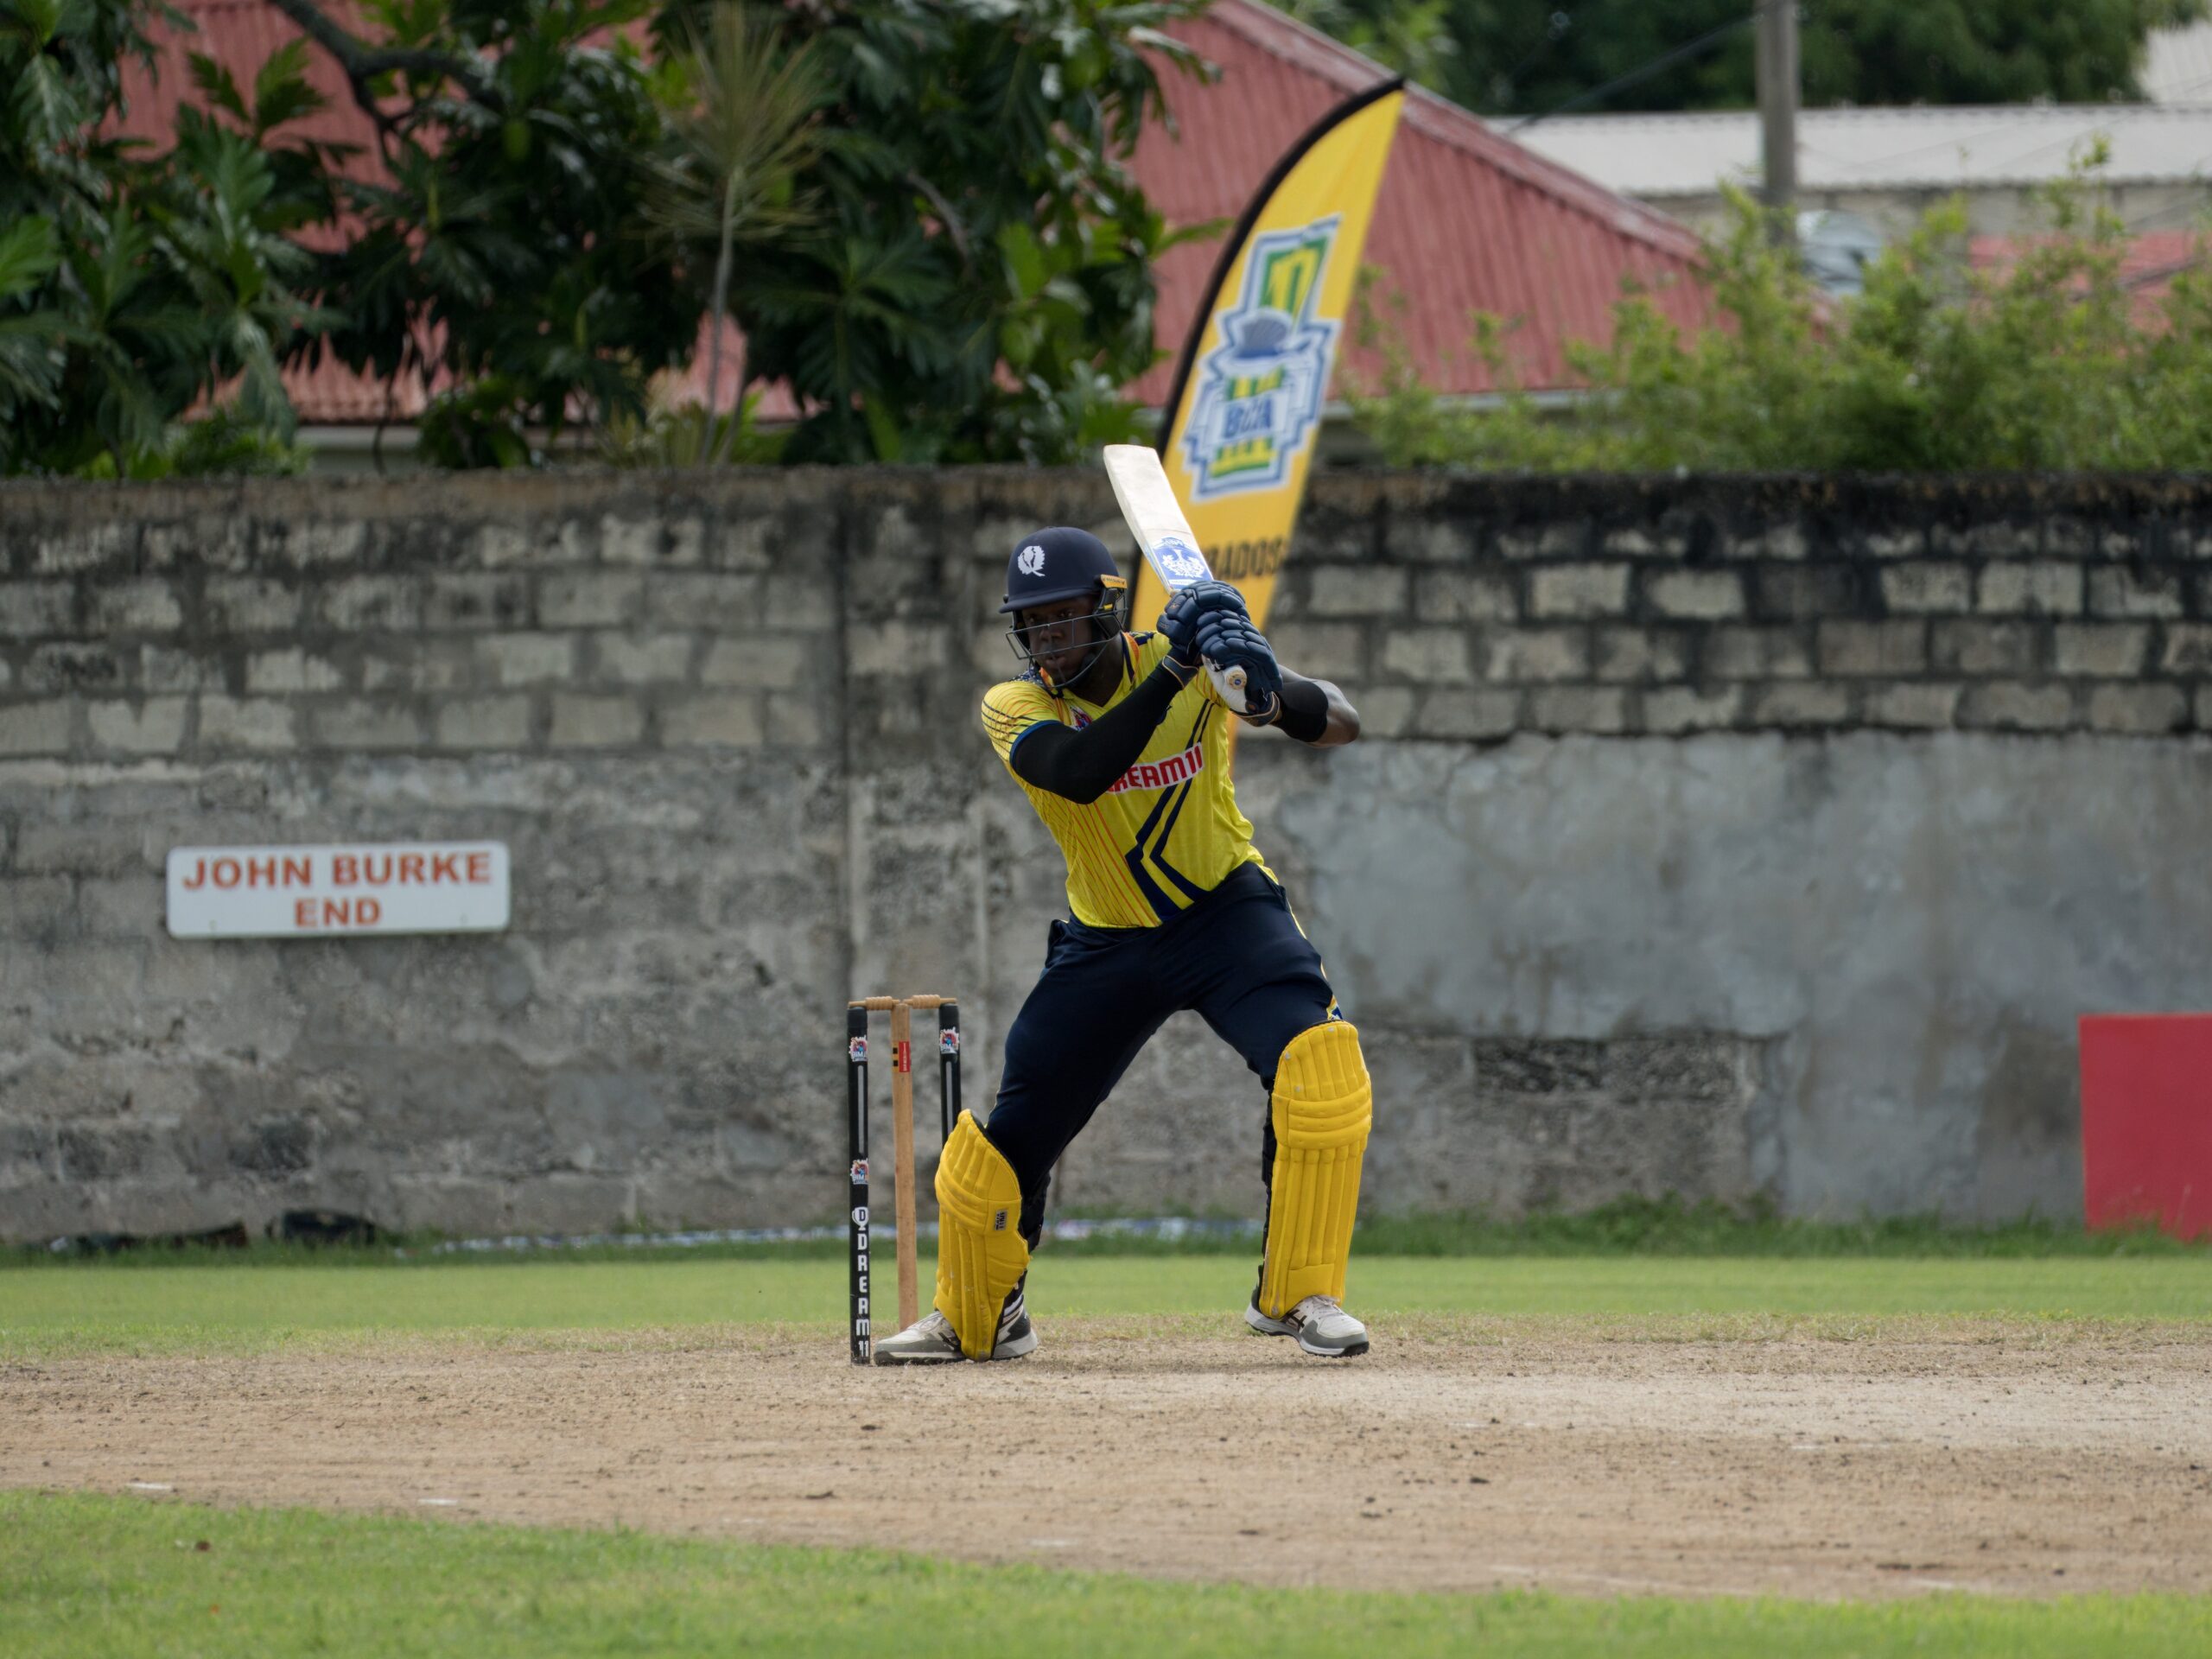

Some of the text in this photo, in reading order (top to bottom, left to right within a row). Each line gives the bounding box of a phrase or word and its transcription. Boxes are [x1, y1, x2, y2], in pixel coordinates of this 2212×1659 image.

[182, 851, 493, 891] JOHN BURKE
[294, 896, 382, 929] END
[856, 1233, 870, 1357] DREAM11
